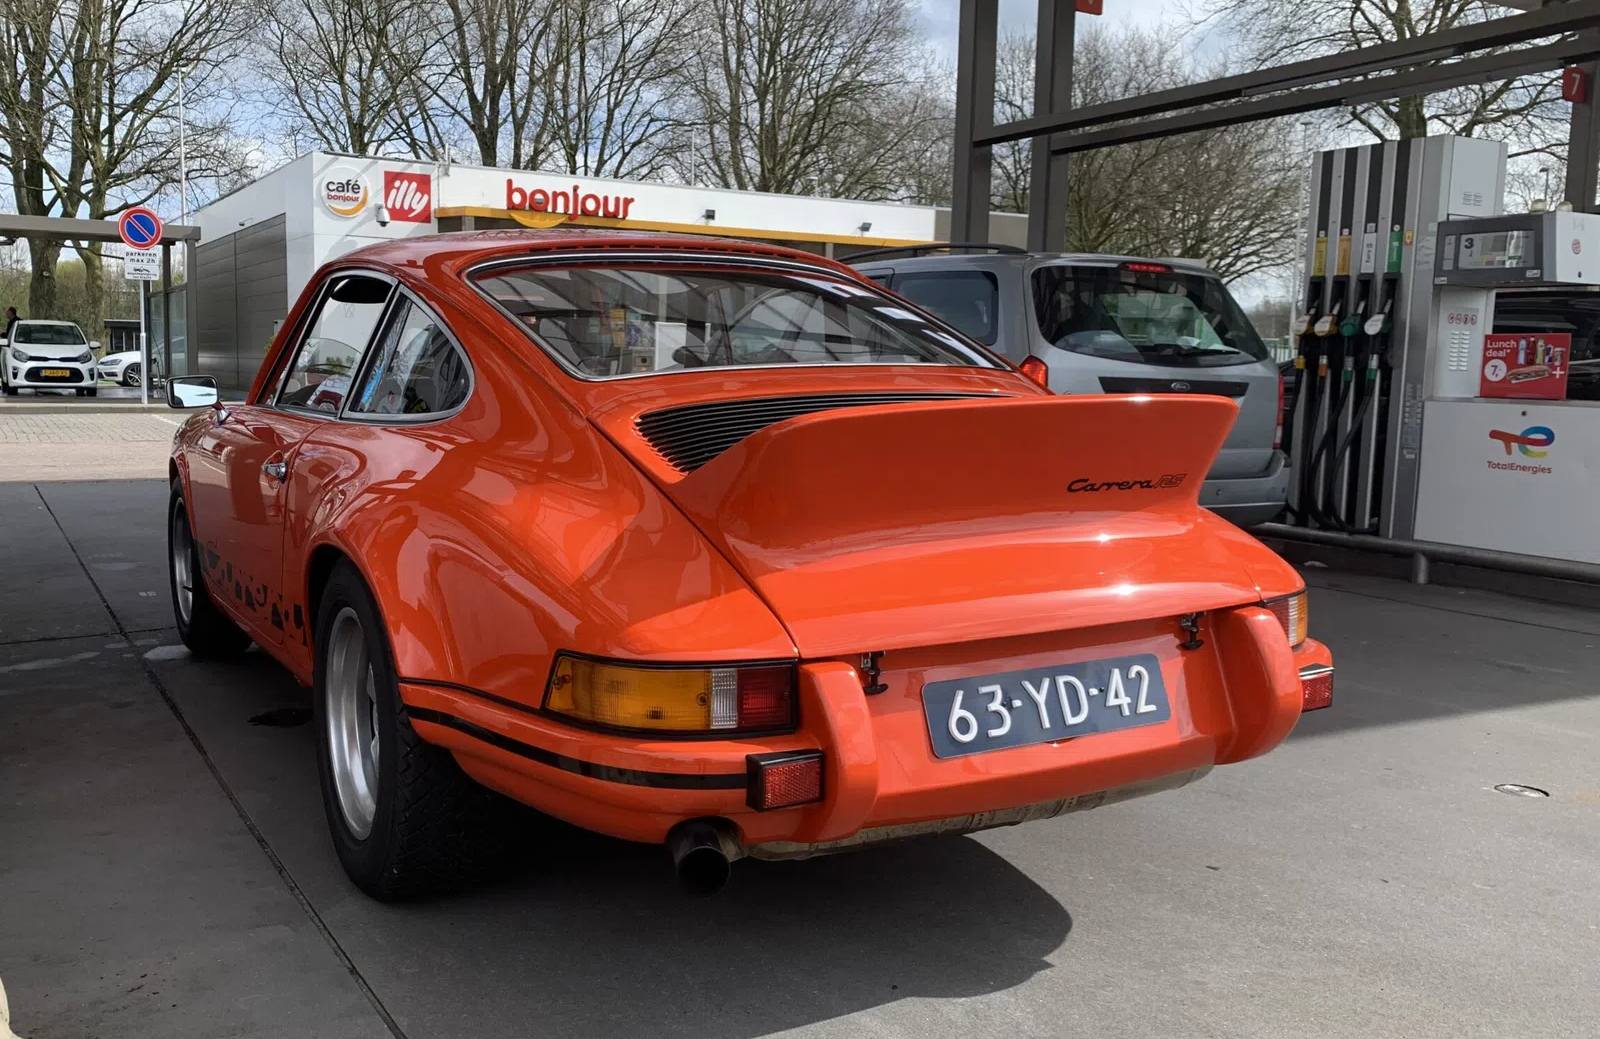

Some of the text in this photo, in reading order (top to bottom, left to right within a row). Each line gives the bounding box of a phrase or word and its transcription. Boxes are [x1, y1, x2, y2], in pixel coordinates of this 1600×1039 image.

[1572, 73, 1580, 96] 7
[326, 180, 360, 194] café
[327, 193, 360, 202] bonjour
[387, 180, 429, 217] illy
[506, 178, 635, 222] bonjour
[1464, 237, 1475, 249] 3
[1487, 339, 1517, 349] Lunch
[1487, 461, 1553, 475] TotalEnergies
[1067, 478, 1153, 493] Carrera
[948, 664, 1158, 744] 63-YD-42
